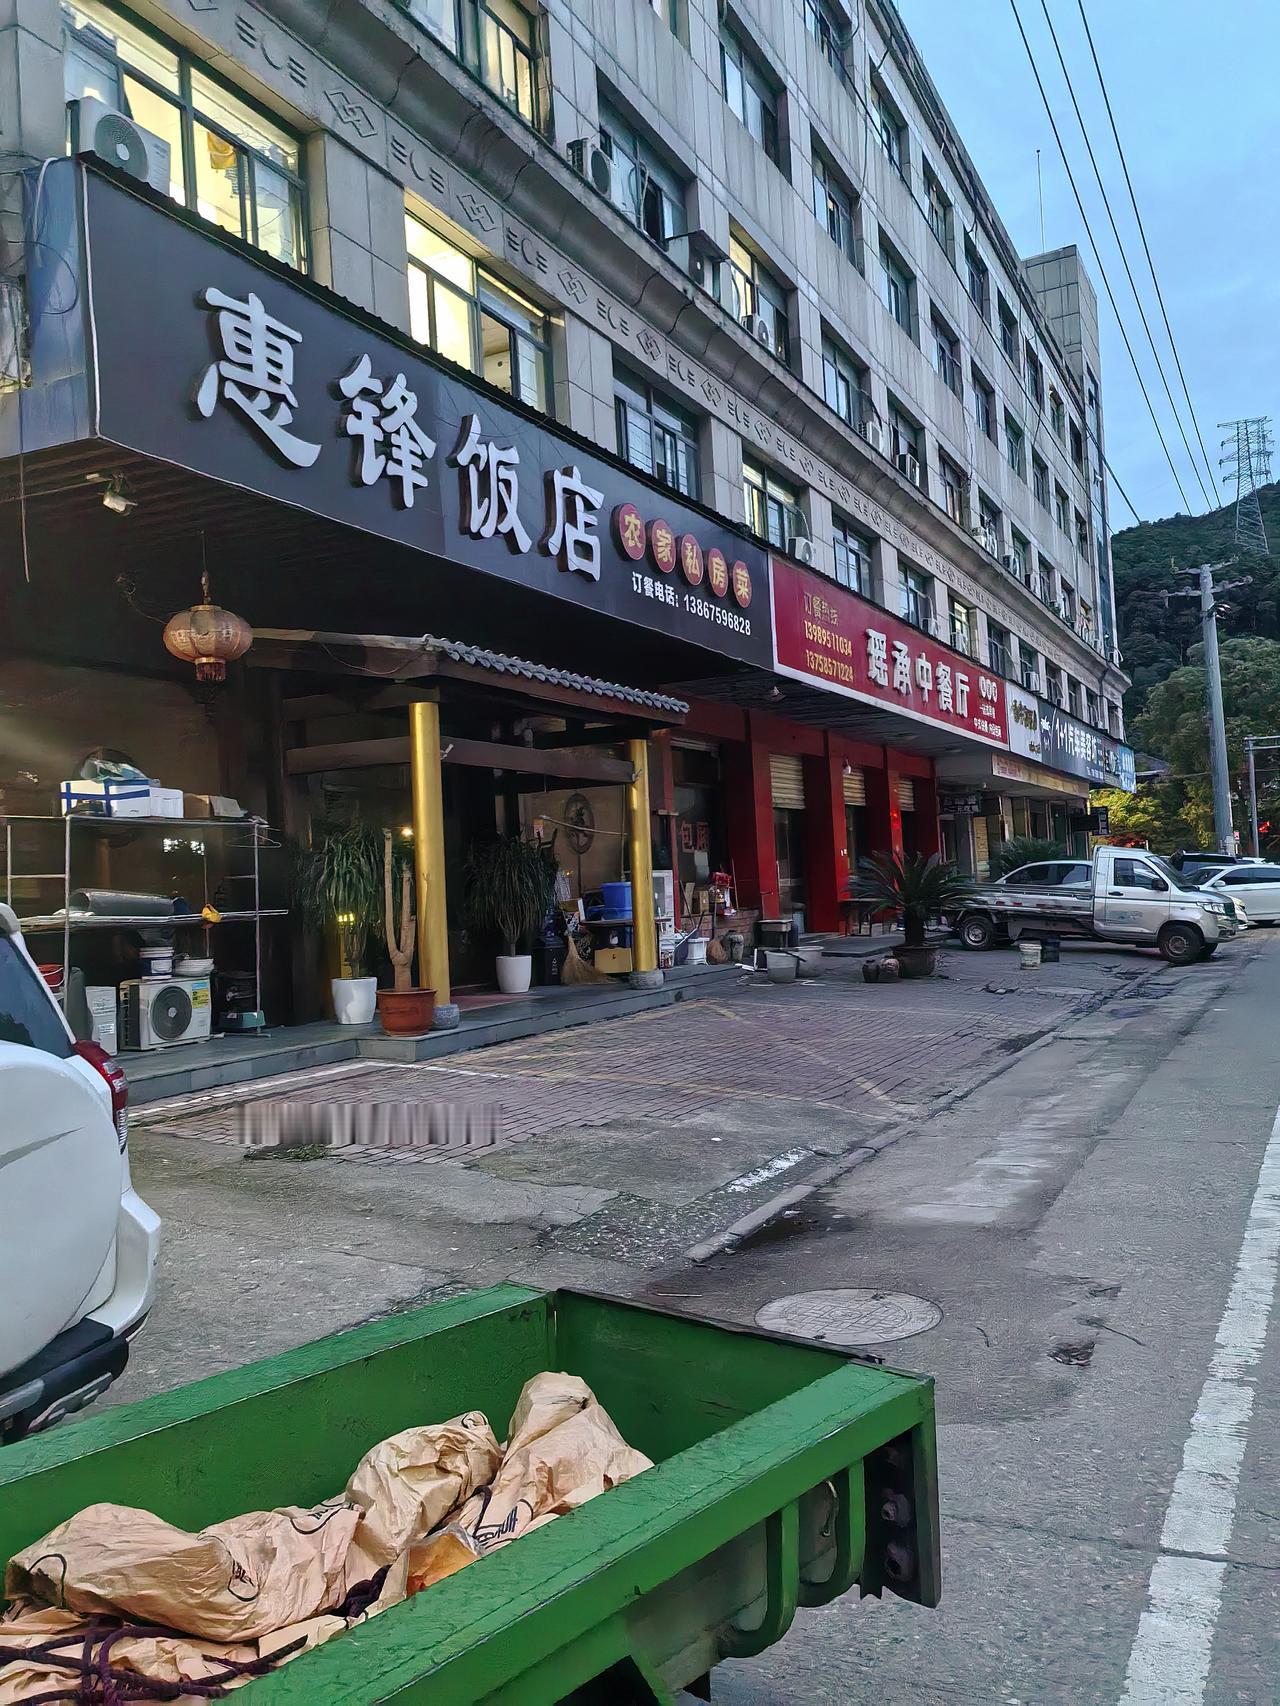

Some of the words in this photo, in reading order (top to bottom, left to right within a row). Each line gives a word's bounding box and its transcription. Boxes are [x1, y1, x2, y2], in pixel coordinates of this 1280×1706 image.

[194, 286, 606, 582] 惠锋饭店
[622, 512, 751, 602] 农家私房菜
[683, 594, 752, 636] 13867596828
